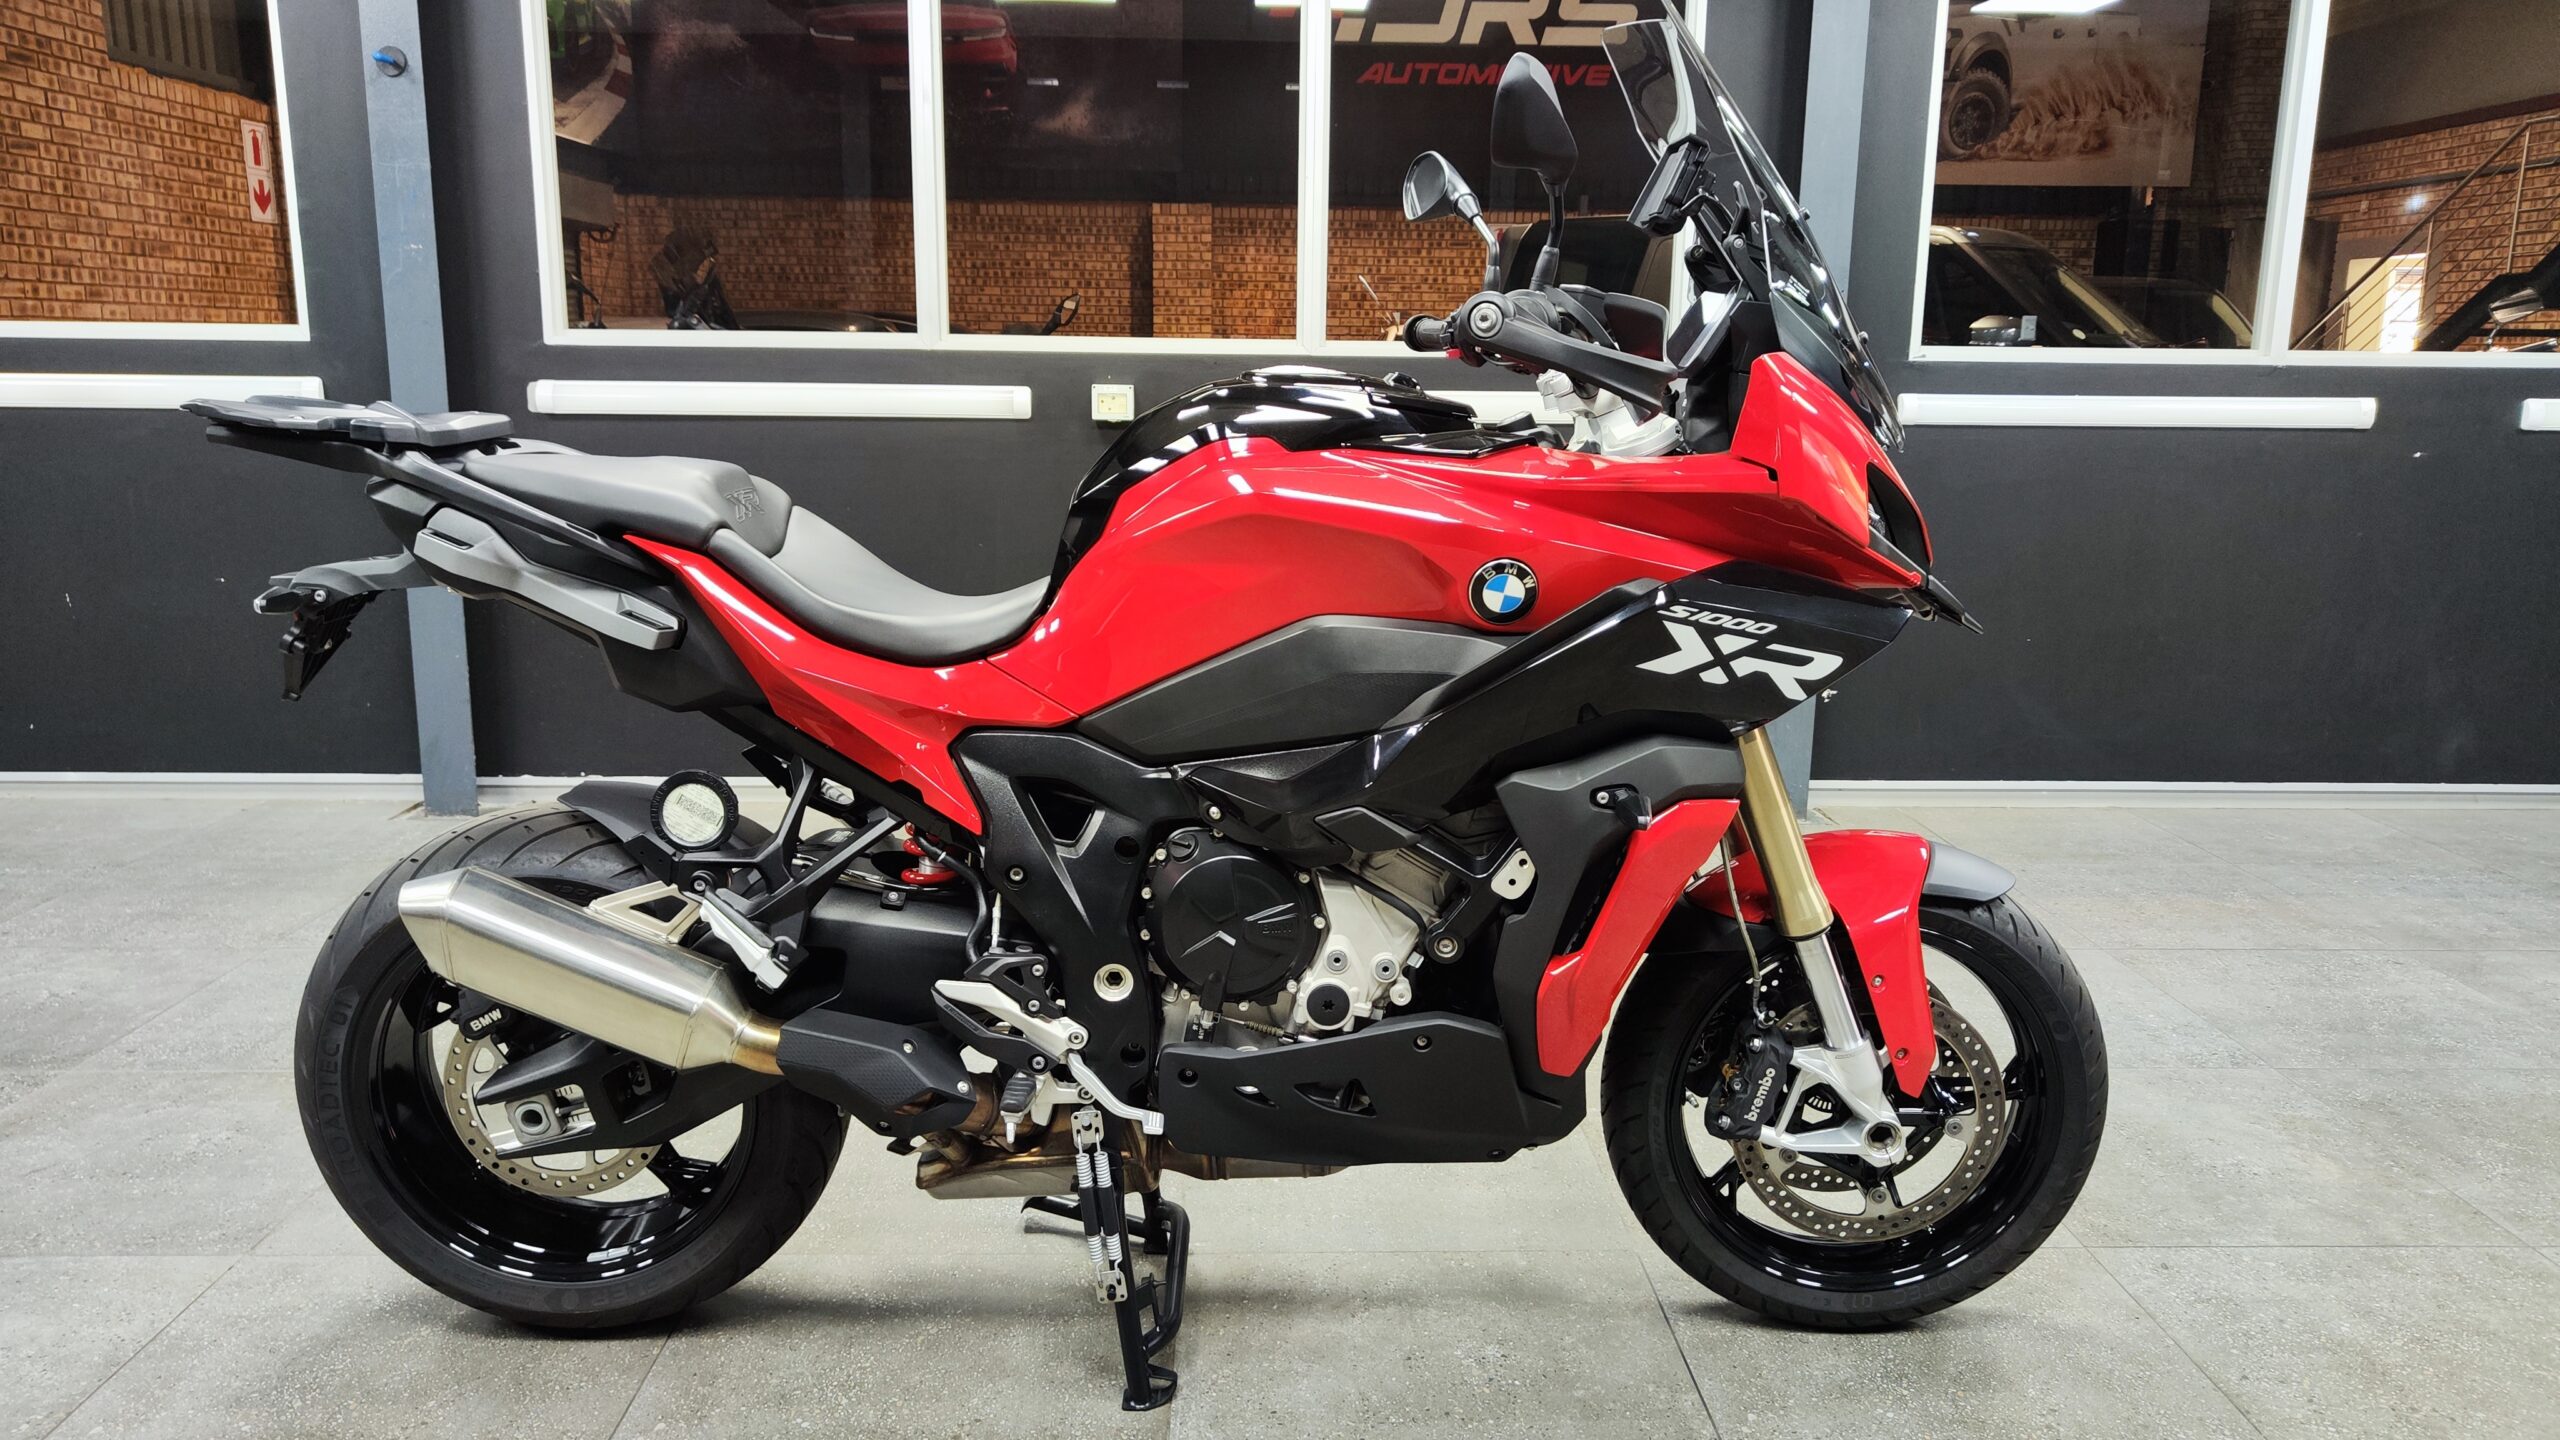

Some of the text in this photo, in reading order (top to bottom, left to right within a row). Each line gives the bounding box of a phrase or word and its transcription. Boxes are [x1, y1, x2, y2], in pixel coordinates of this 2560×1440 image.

[1355, 62, 1612, 86] AUTOMIVE
[1481, 563, 1536, 589] BMW
[1657, 605, 1778, 635] S1000
[1635, 620, 1844, 701] XR
[470, 1008, 502, 1031] BMW
[1743, 1067, 1776, 1122] brembo
